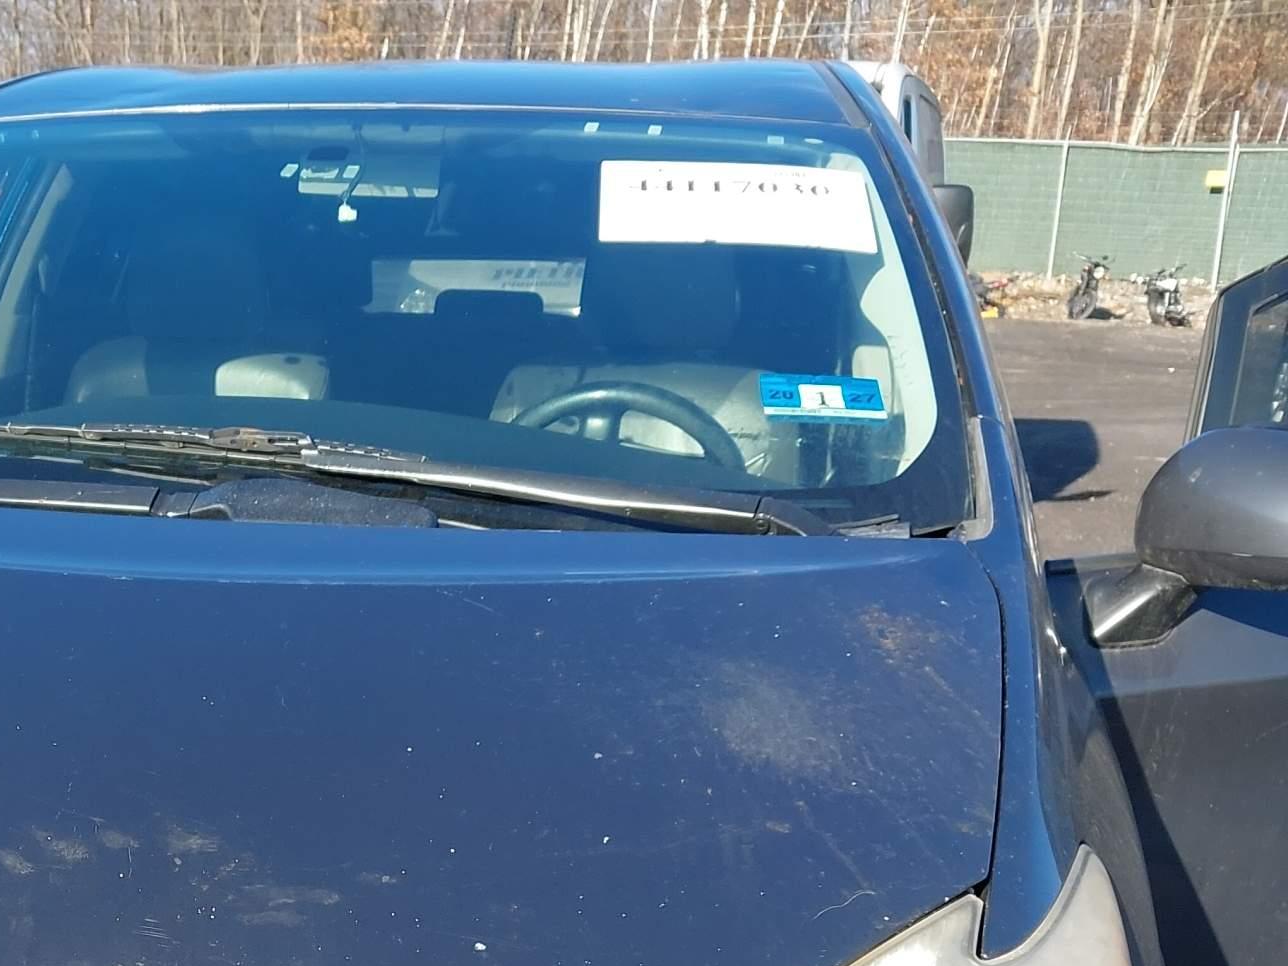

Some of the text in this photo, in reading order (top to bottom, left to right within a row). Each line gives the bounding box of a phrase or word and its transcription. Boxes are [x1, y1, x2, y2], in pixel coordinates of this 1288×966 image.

[768, 389, 876, 408] 20 1 27
